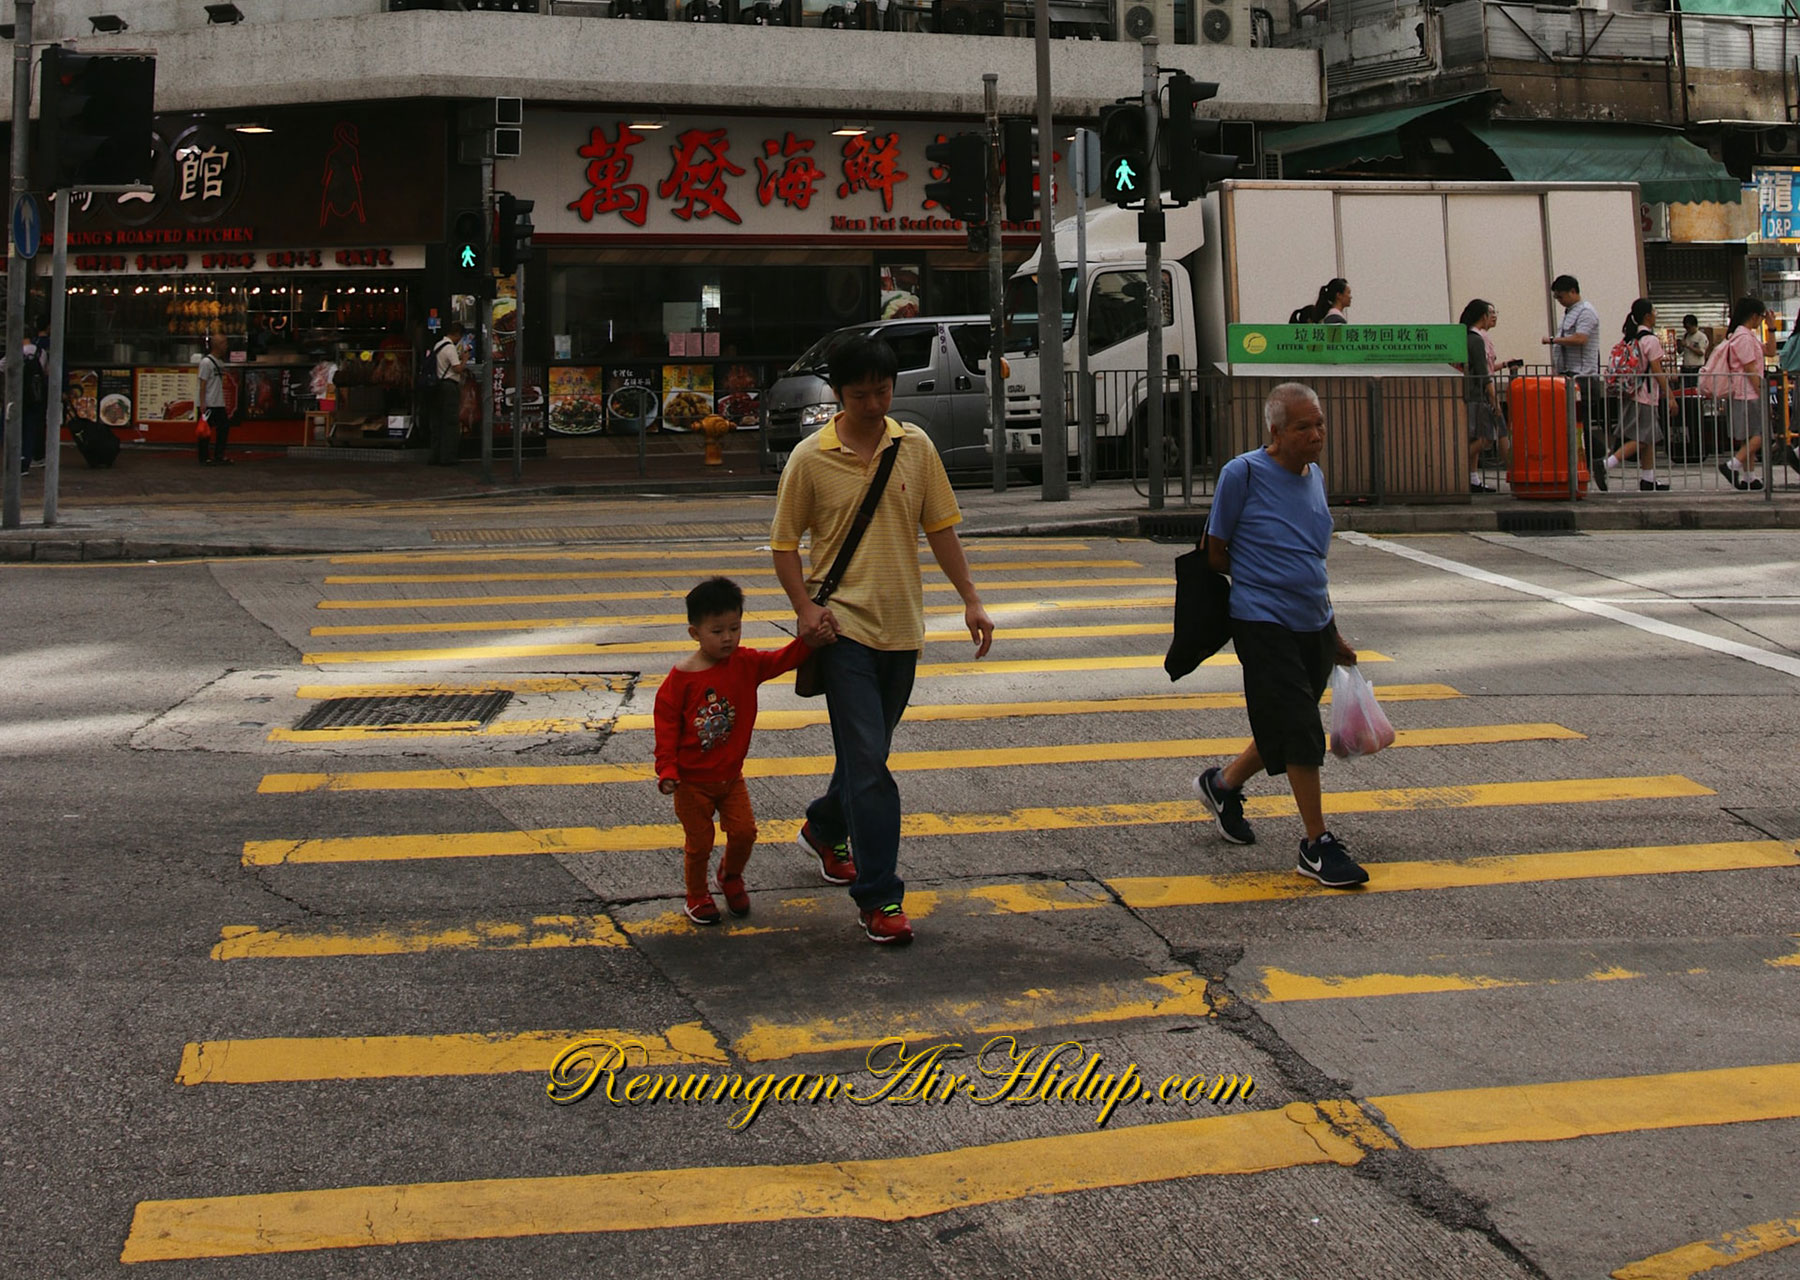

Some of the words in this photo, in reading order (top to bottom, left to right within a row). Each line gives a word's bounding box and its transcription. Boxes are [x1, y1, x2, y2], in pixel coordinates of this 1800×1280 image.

[567, 123, 1062, 227] 萬發海鮮
[831, 215, 866, 230] Man
[870, 215, 896, 230] Fat
[1767, 218, 1792, 238] D&P
[116, 229, 182, 244] ROASTED
[185, 226, 254, 243] KITCHEN
[938, 326, 948, 354] 890
